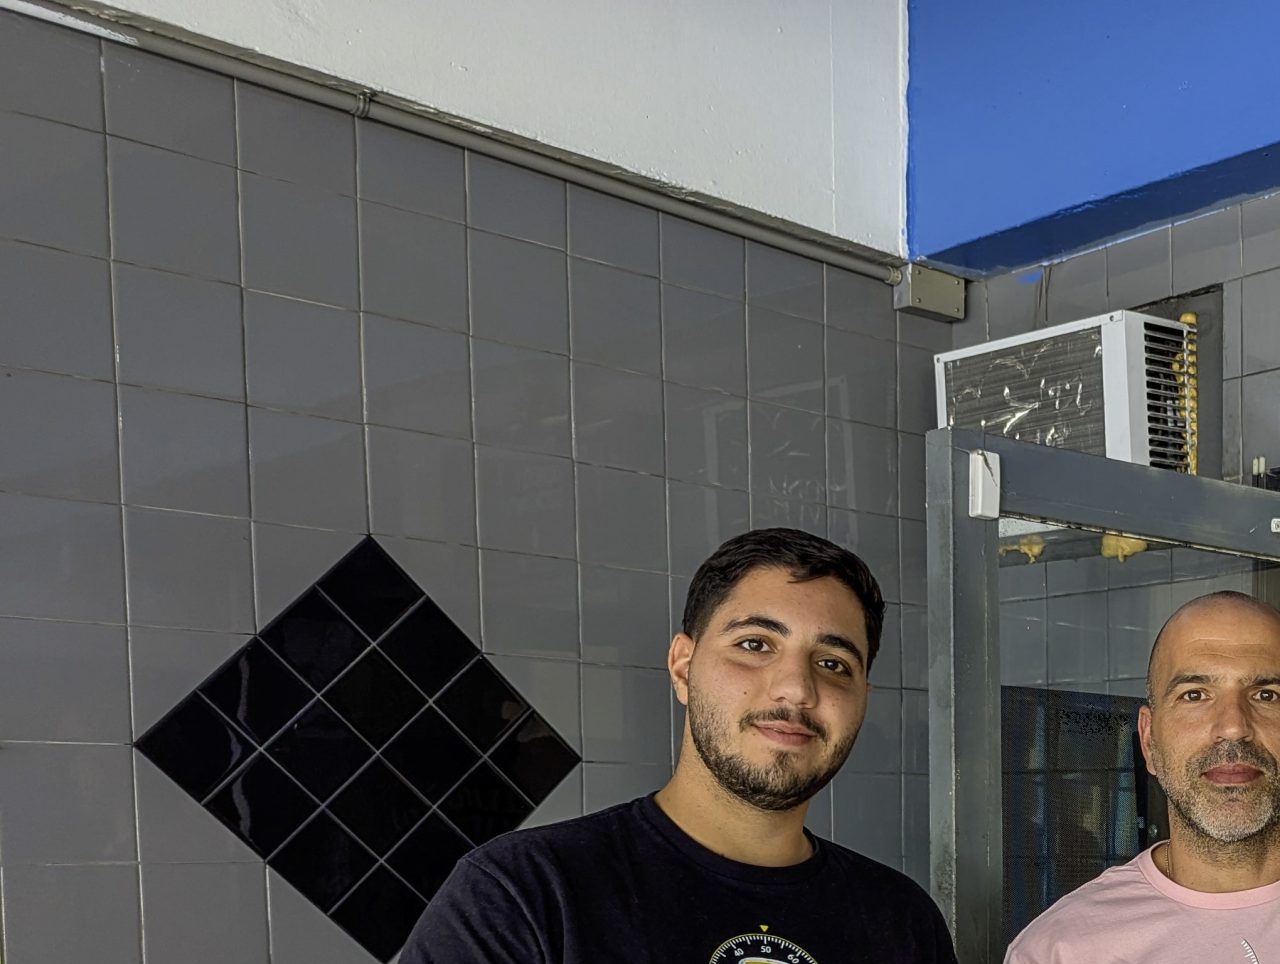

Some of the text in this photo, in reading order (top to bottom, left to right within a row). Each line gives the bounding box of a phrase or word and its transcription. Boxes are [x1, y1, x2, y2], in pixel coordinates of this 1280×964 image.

[734, 948, 744, 957] 40
[760, 945, 772, 954] 50
[787, 953, 800, 964] 60
